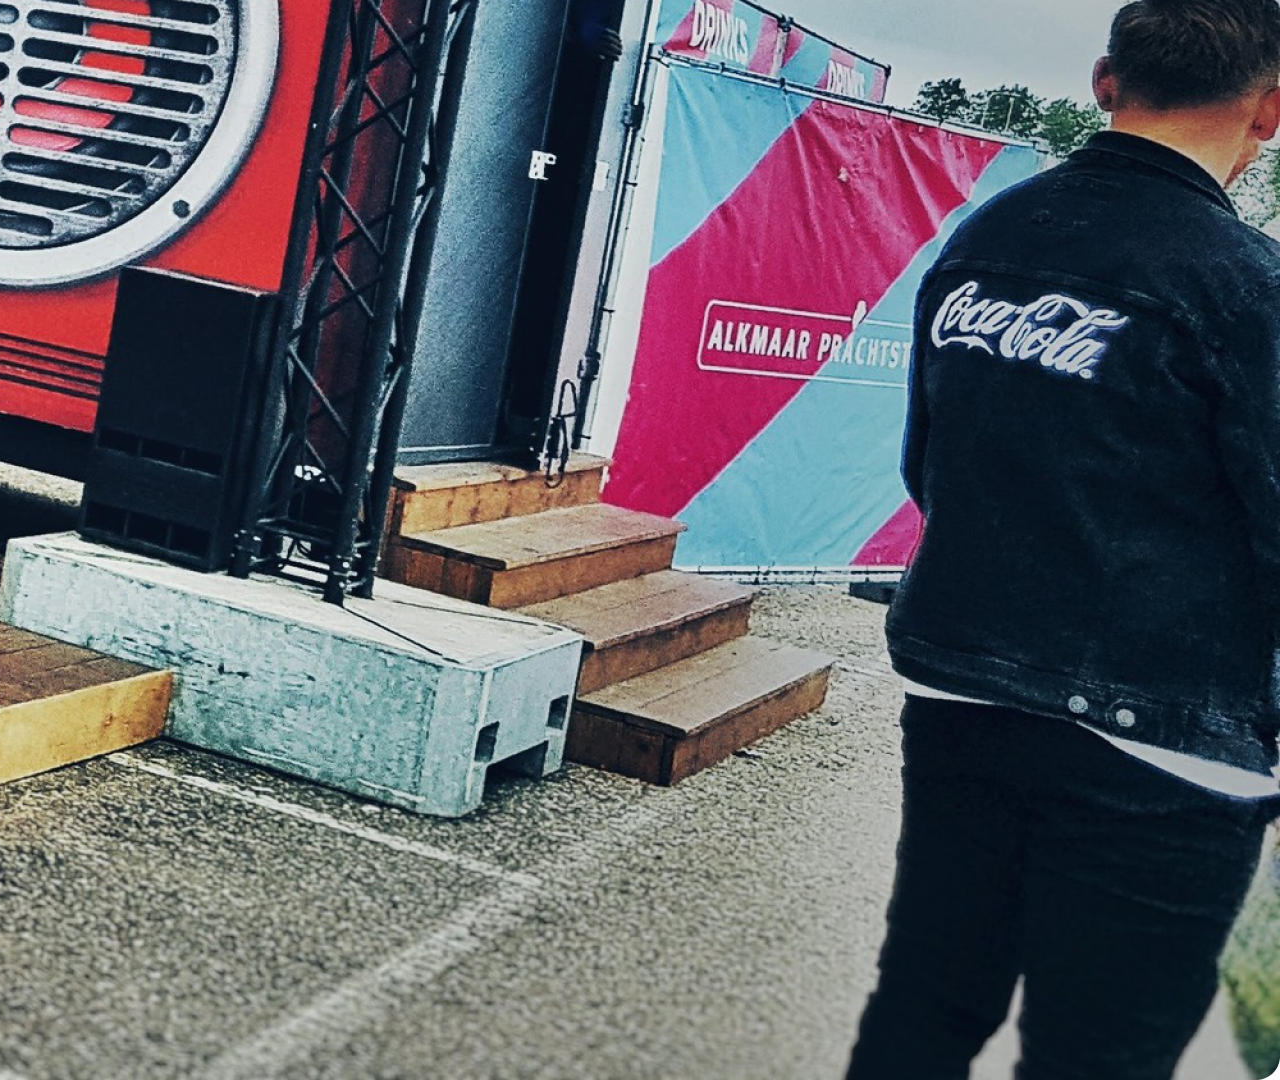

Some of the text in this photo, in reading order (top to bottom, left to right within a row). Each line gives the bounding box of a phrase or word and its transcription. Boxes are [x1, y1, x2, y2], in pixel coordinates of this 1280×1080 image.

[707, 319, 912, 369] ALKMAAR PRACHTST
[931, 281, 1130, 379] Coca-Cola
